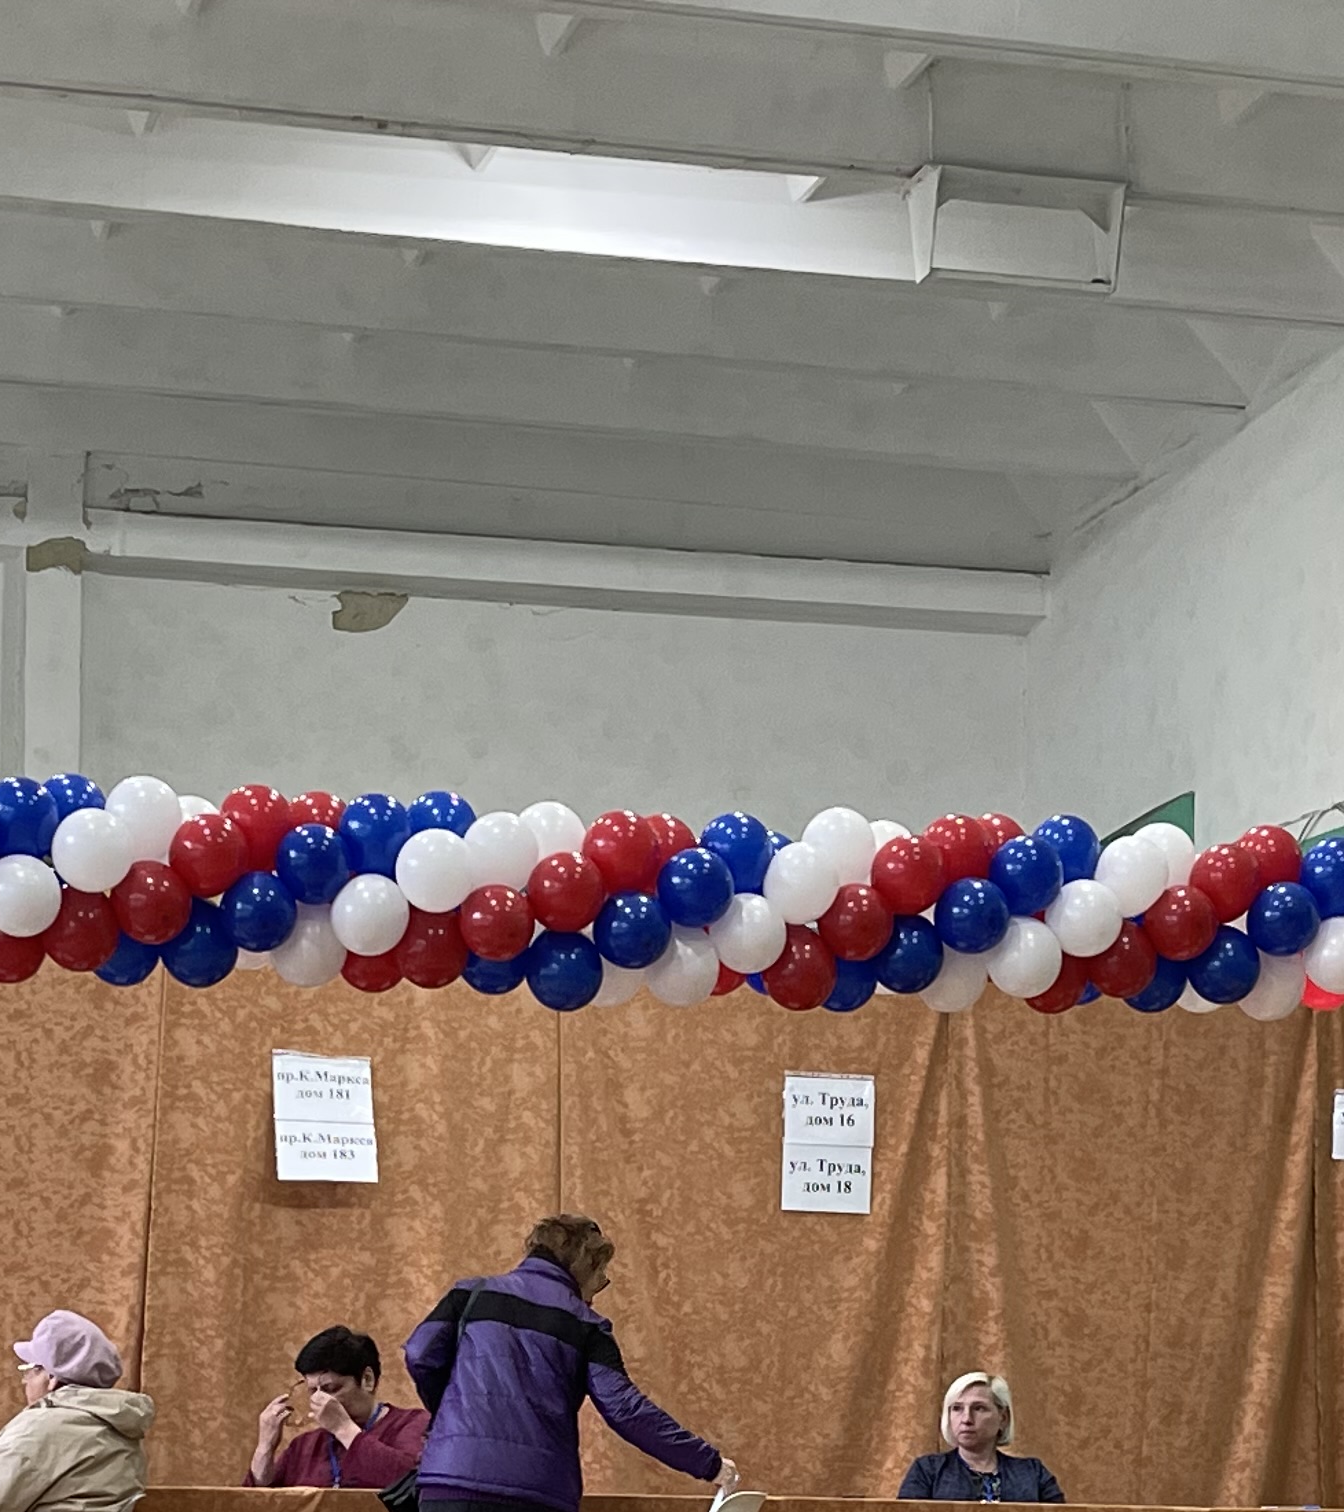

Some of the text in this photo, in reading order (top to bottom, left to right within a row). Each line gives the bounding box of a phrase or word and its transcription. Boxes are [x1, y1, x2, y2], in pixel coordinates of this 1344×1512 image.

[295, 1088, 350, 1100] дом 181
[818, 1092, 869, 1110] Труда,
[806, 1113, 855, 1127] дом 16
[300, 1149, 355, 1160] дом 183
[789, 1158, 866, 1176] ул. Труда,
[802, 1180, 852, 1194] дом 18
